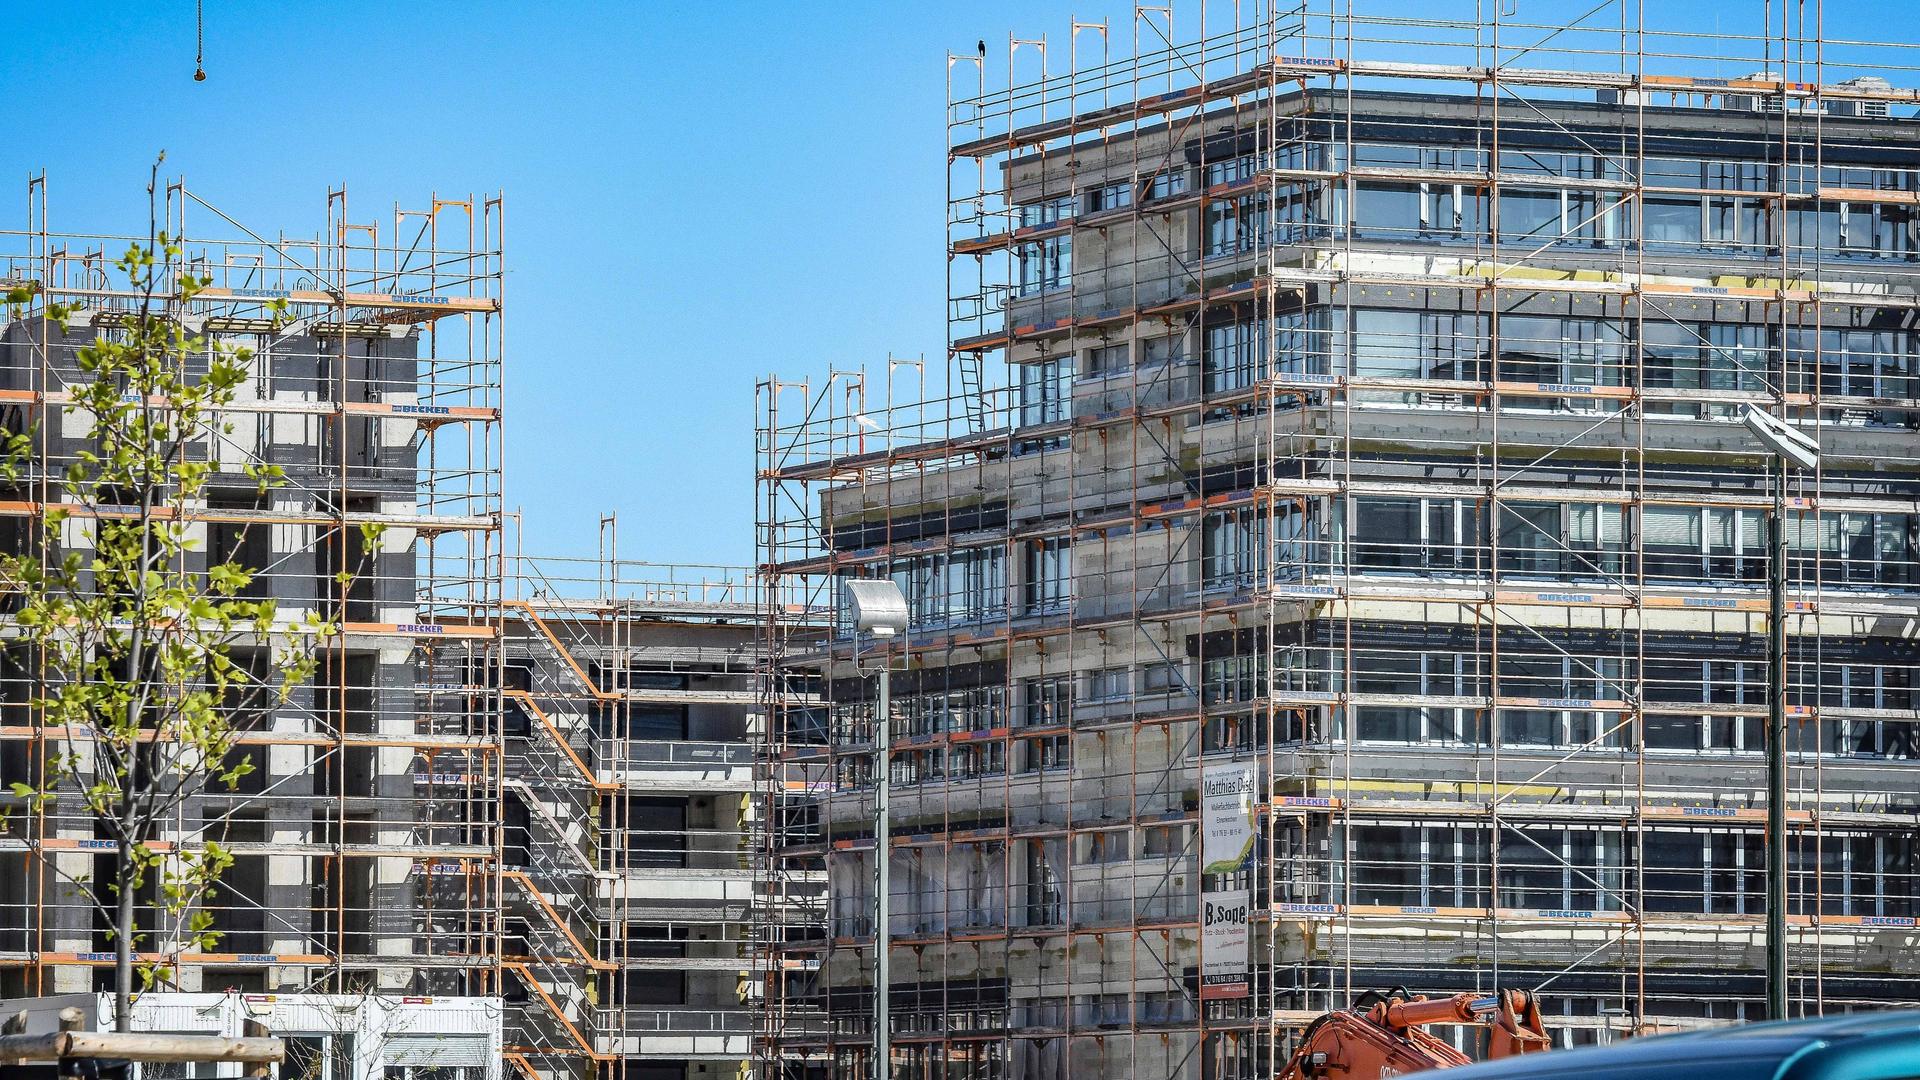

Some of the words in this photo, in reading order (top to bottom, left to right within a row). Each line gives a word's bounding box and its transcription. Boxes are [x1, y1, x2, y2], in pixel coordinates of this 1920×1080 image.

[1291, 57, 1335, 66] BECKER
[1699, 79, 1728, 87] BECKER
[242, 289, 291, 298] BECKER
[402, 295, 449, 304] BECKER
[1290, 374, 1335, 383] BECKER
[1548, 384, 1592, 393] BECKER
[402, 405, 449, 414] BECKER
[1290, 585, 1335, 594] BECKER
[1547, 594, 1592, 602] BECKER
[408, 625, 443, 633] BECKER
[1549, 699, 1592, 707] BECKER
[1204, 778, 1236, 796] Matthias
[1295, 798, 1330, 807] BECKER
[1693, 808, 1736, 816] BECKER
[1290, 904, 1335, 912] BECKER
[1548, 910, 1593, 919] BECKER
[1871, 916, 1914, 925] BECKER
[245, 954, 277, 962] BECKER
